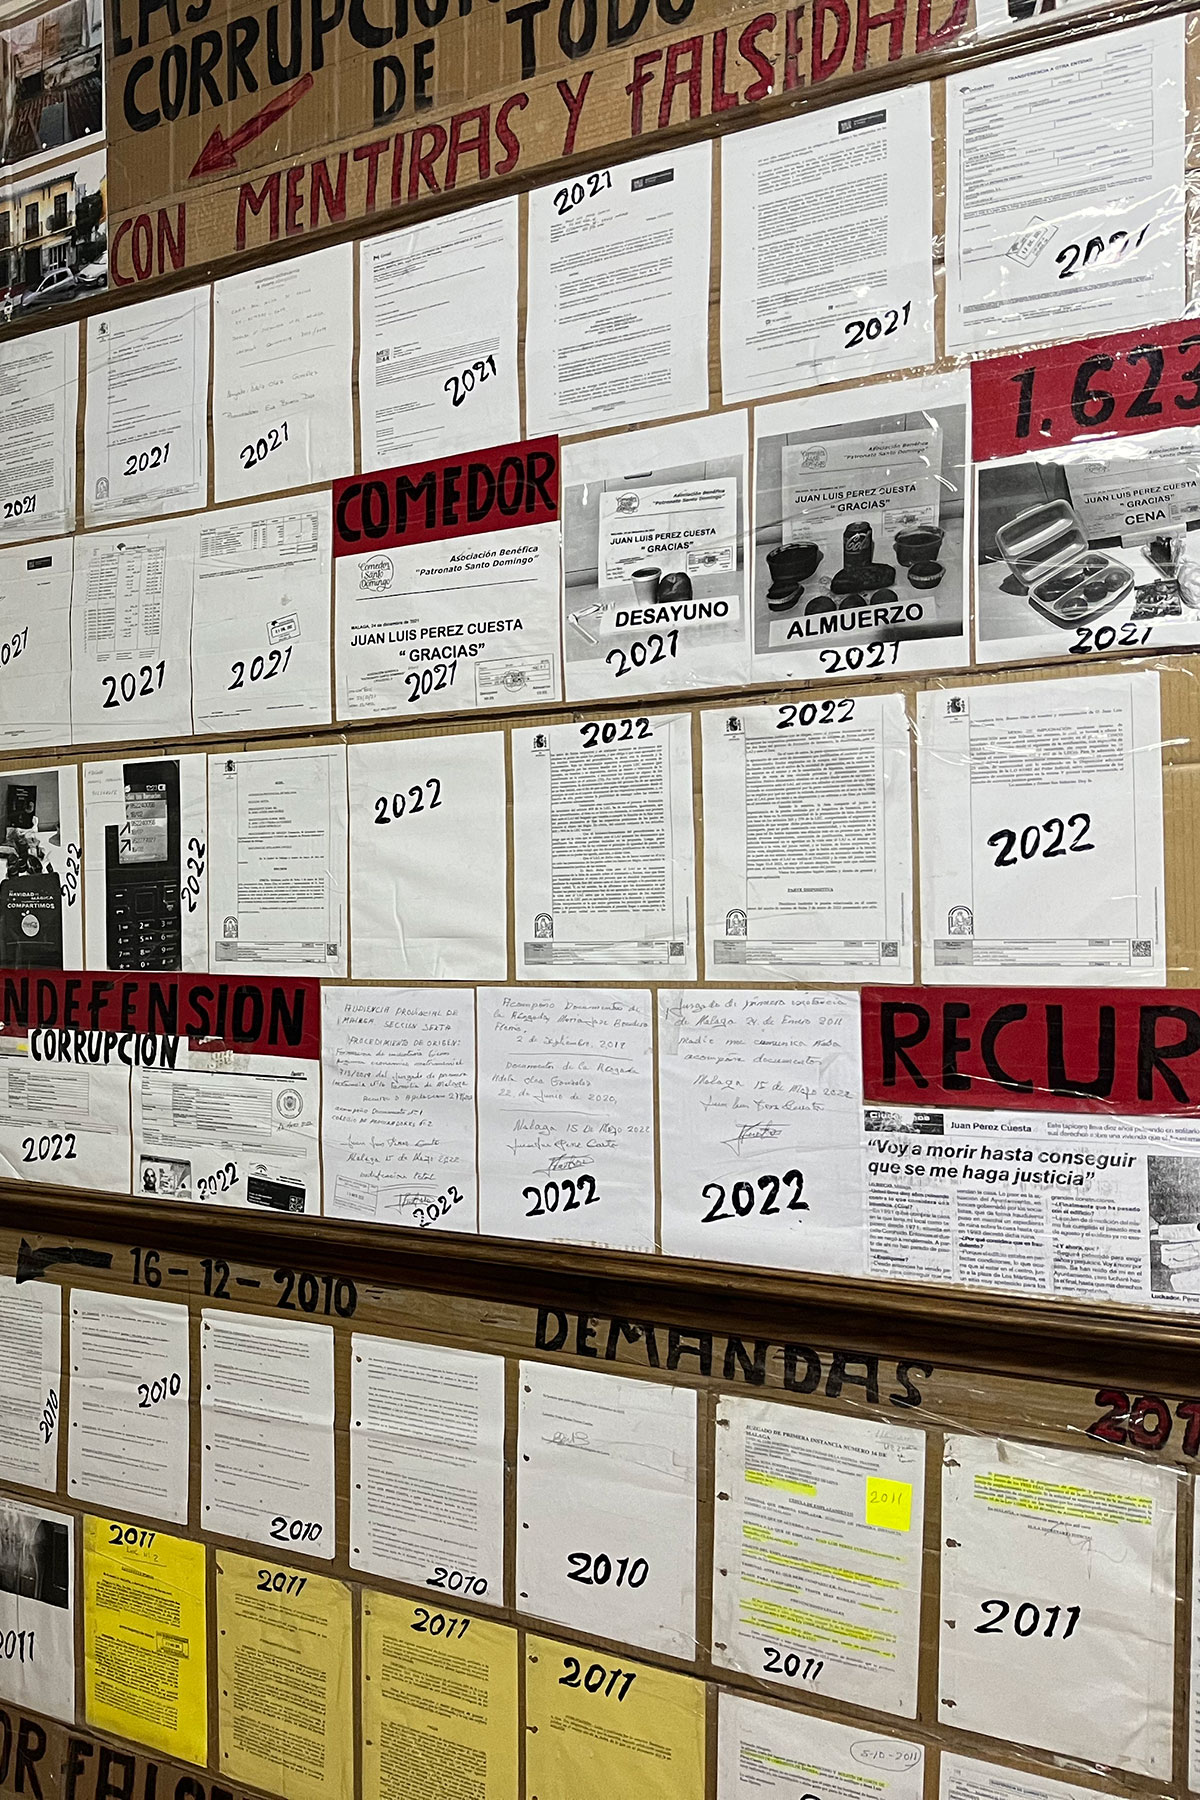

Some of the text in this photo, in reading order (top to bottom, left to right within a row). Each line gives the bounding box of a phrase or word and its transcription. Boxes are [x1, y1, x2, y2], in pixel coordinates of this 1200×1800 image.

[373, 38, 435, 128] DE
[110, 202, 186, 288] CON
[236, 92, 530, 251] MENTIRAS
[557, 71, 593, 155] Y
[553, 170, 612, 216] 2021
[844, 301, 912, 349] 2021
[444, 355, 498, 406] 2021
[123, 443, 171, 477] 2021
[239, 421, 290, 469] 2021
[3, 494, 37, 519] 2021
[336, 451, 557, 543] COMEDOR
[795, 484, 916, 504] JUAN LUIS PEREZ CUESTA
[1085, 480, 1197, 504] JUAN LUIS PEREZ CUESTA
[1124, 509, 1166, 526] CENA
[449, 545, 539, 563] Asociación Benéfica
[610, 527, 716, 545] JUAN LUIS PEREZ CUESTA
[464, 561, 491, 572] Santo
[615, 600, 729, 628] DESAYUNO
[786, 603, 923, 640] ALMUERZO
[350, 618, 523, 647] JUAN LUIS PEREZ CUESTA
[1069, 622, 1153, 655] 2021
[227, 645, 293, 691] 2021
[605, 629, 679, 678] 2021
[819, 640, 902, 673] 2021
[101, 660, 166, 708] 2021
[405, 660, 457, 702] 2021
[776, 698, 856, 729] 2022
[580, 717, 654, 749] 2022
[373, 777, 443, 825] 2022
[987, 812, 1097, 868] 2022
[61, 842, 83, 907] 2022
[181, 836, 206, 913] 2022
[30, 1028, 181, 1070] CORRUPCION
[950, 1121, 971, 1130] Juan
[1000, 1124, 1032, 1133] Cuesta
[21, 1132, 78, 1163] 2022
[911, 1144, 922, 1155] a
[926, 1145, 977, 1159] morir
[980, 1145, 1033, 1162] hasta
[1037, 1151, 1137, 1170] conseguir
[197, 1161, 240, 1201] 2022
[868, 1161, 901, 1175] que
[904, 1164, 925, 1176] se
[929, 1166, 958, 1178] me
[962, 1165, 1009, 1183] haga
[412, 1185, 464, 1228] 2022
[522, 1174, 601, 1217] 2022
[701, 1169, 810, 1223] 2022
[535, 1307, 934, 1409] DEMANDAS
[138, 1372, 181, 1408] 2010
[39, 1389, 58, 1443] 2010
[870, 1491, 902, 1505] 2011
[108, 1524, 156, 1549] 2011
[269, 1516, 323, 1542] 2010
[256, 1570, 308, 1597] 2011
[426, 1567, 488, 1596] 2010
[567, 1552, 649, 1589] 2010
[410, 1608, 471, 1639] 2011
[973, 1599, 1081, 1640] 2011
[559, 1657, 637, 1701] 2011
[763, 1647, 824, 1681] 2011
